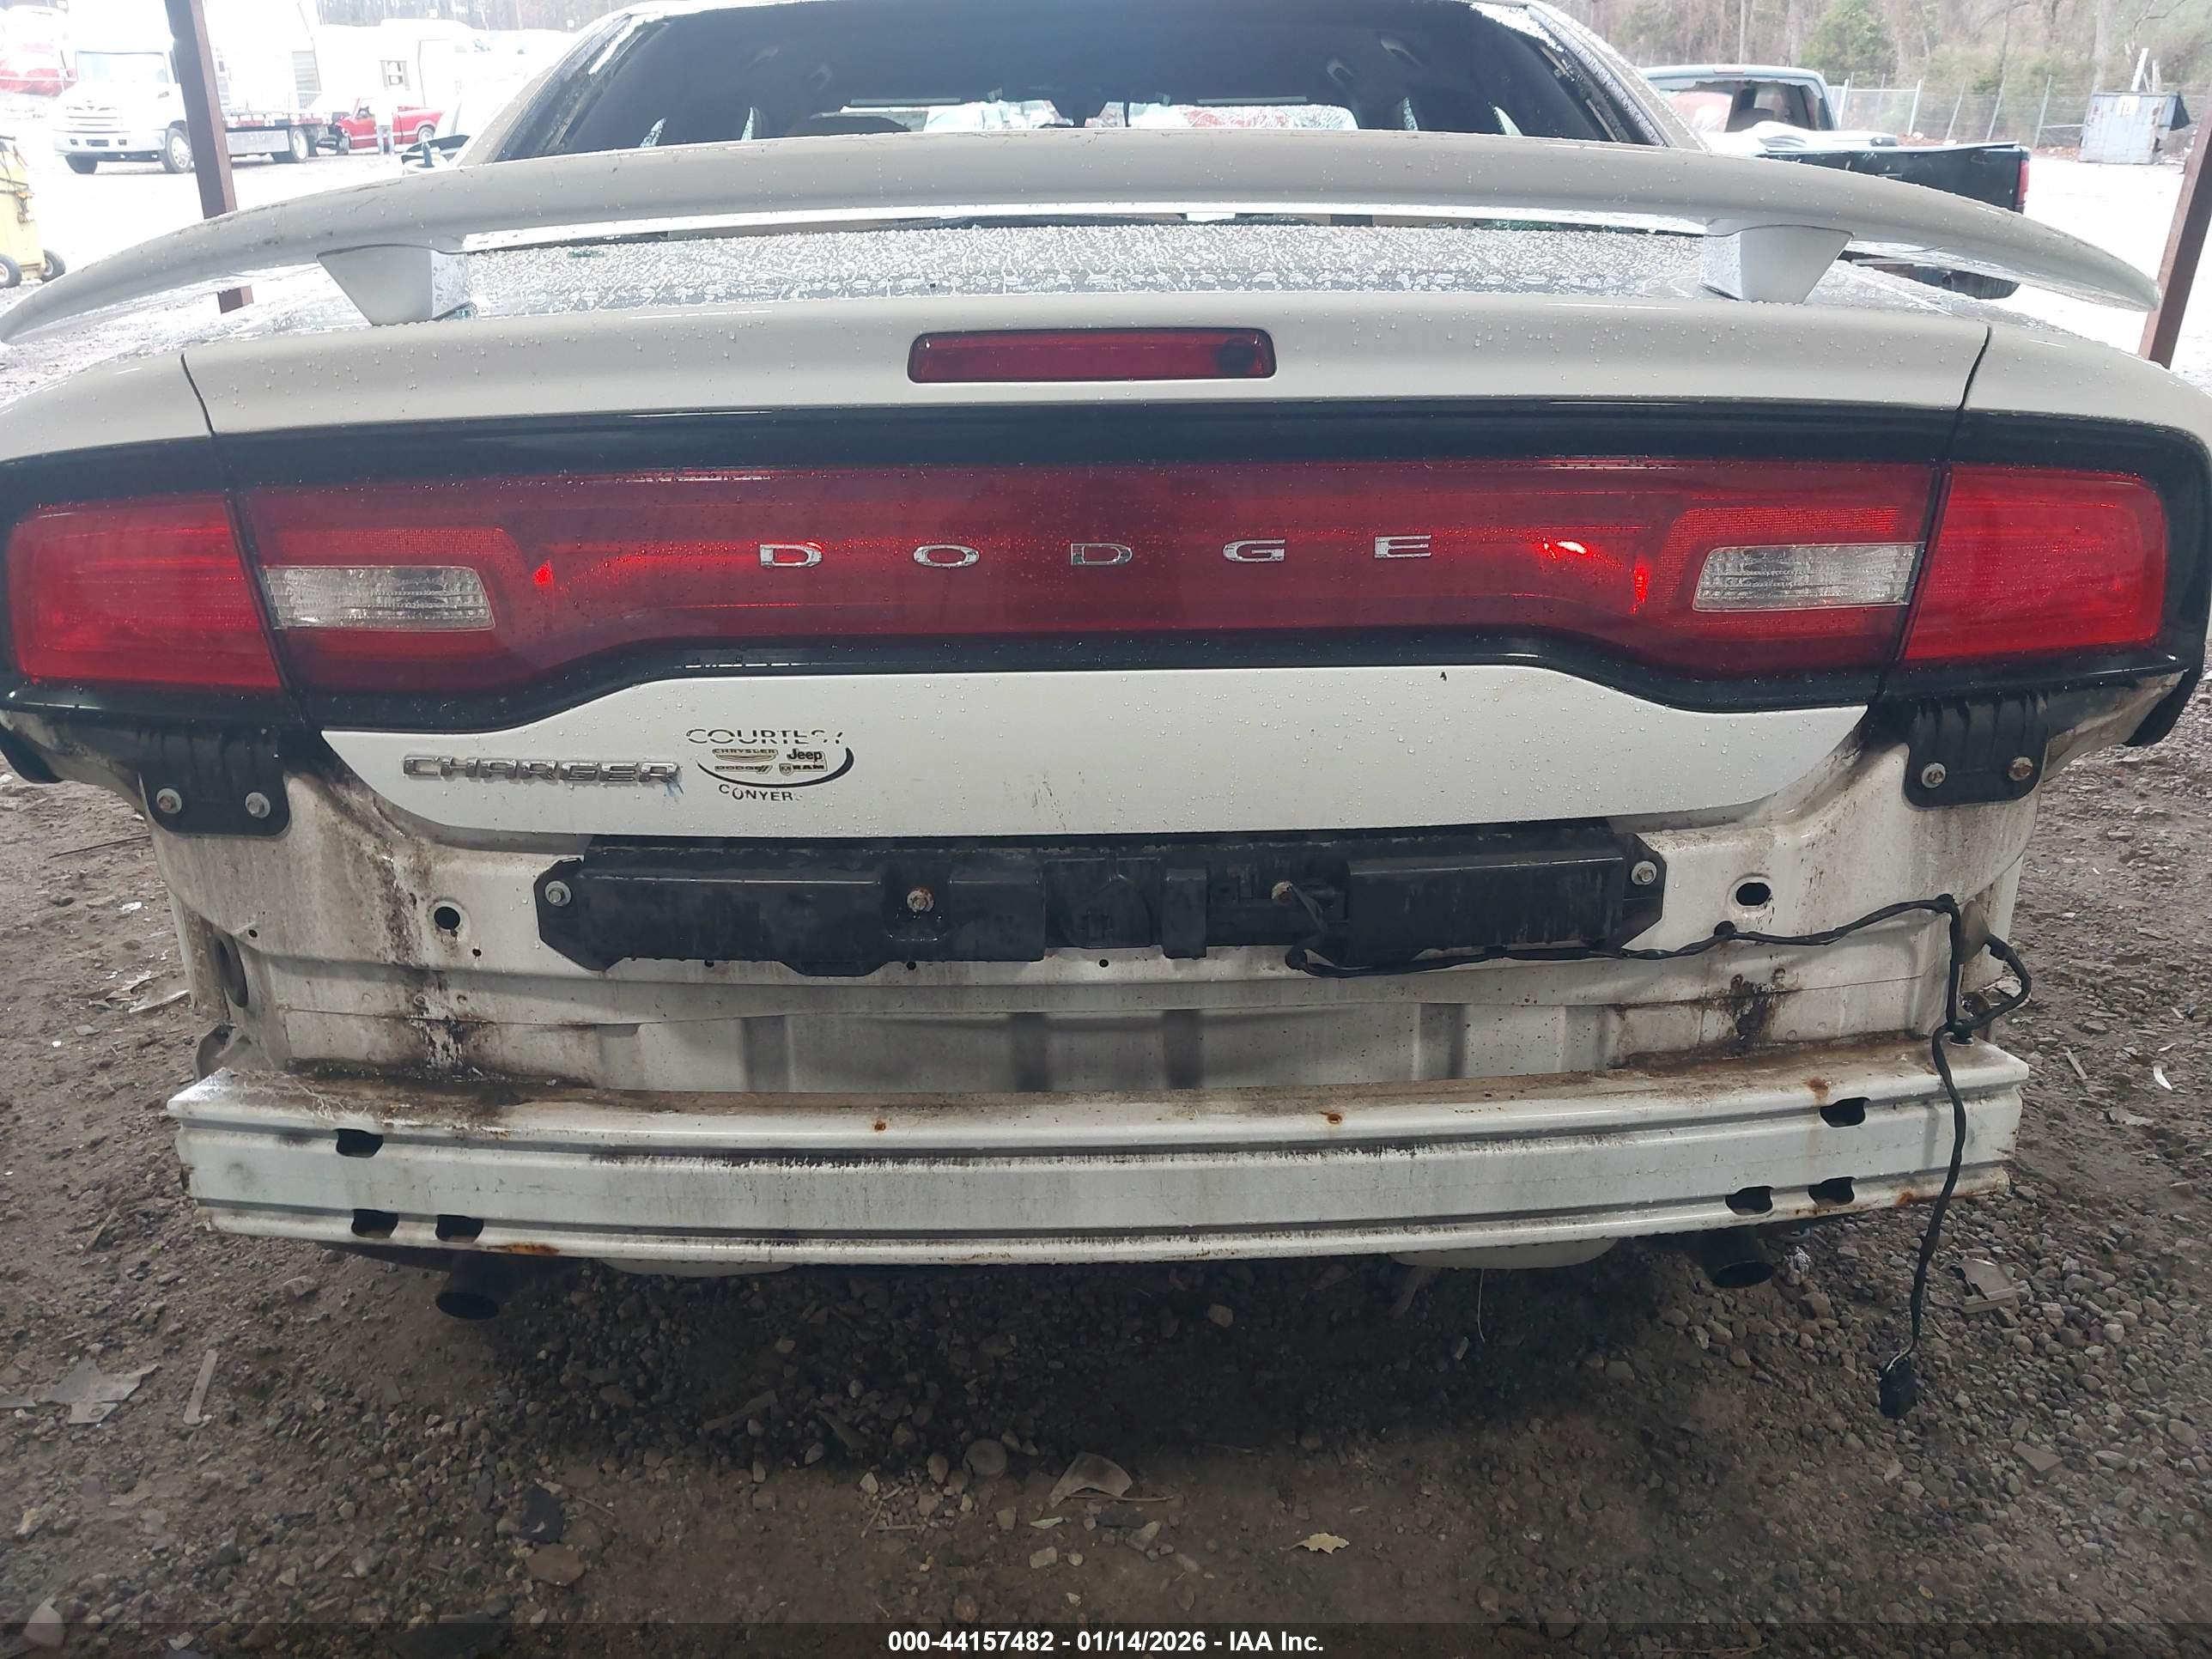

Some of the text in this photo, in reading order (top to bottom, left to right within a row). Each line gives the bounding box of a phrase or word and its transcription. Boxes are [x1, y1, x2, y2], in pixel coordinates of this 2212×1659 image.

[759, 534, 1432, 568] DODGE
[787, 748, 823, 763] Jeep
[403, 755, 681, 783] CHARGER
[718, 783, 803, 802] CONYER
